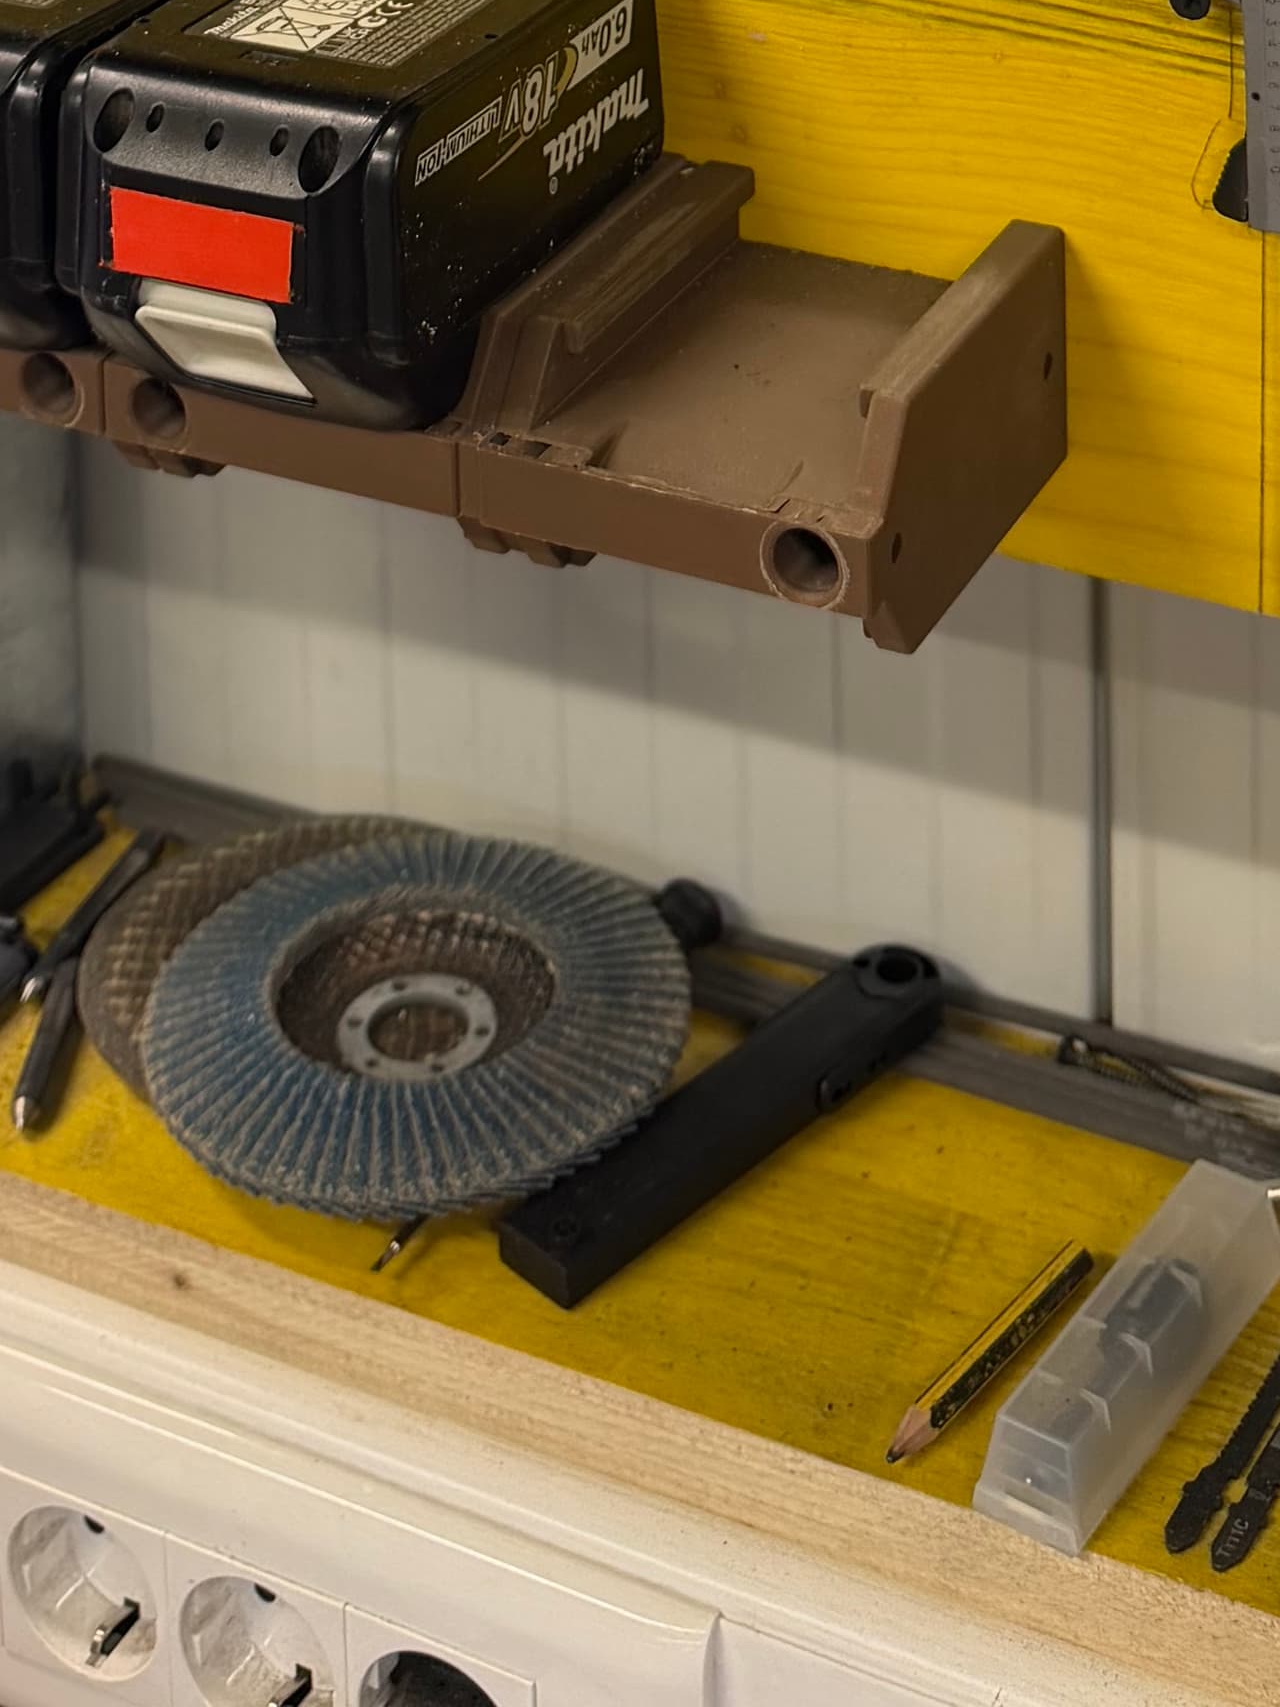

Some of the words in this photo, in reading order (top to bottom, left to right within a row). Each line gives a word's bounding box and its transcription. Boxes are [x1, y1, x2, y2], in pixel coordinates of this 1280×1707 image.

[581, 6, 628, 58] 6.0Ah
[500, 53, 559, 141] 18V
[417, 100, 500, 184] LITHIUM-ION
